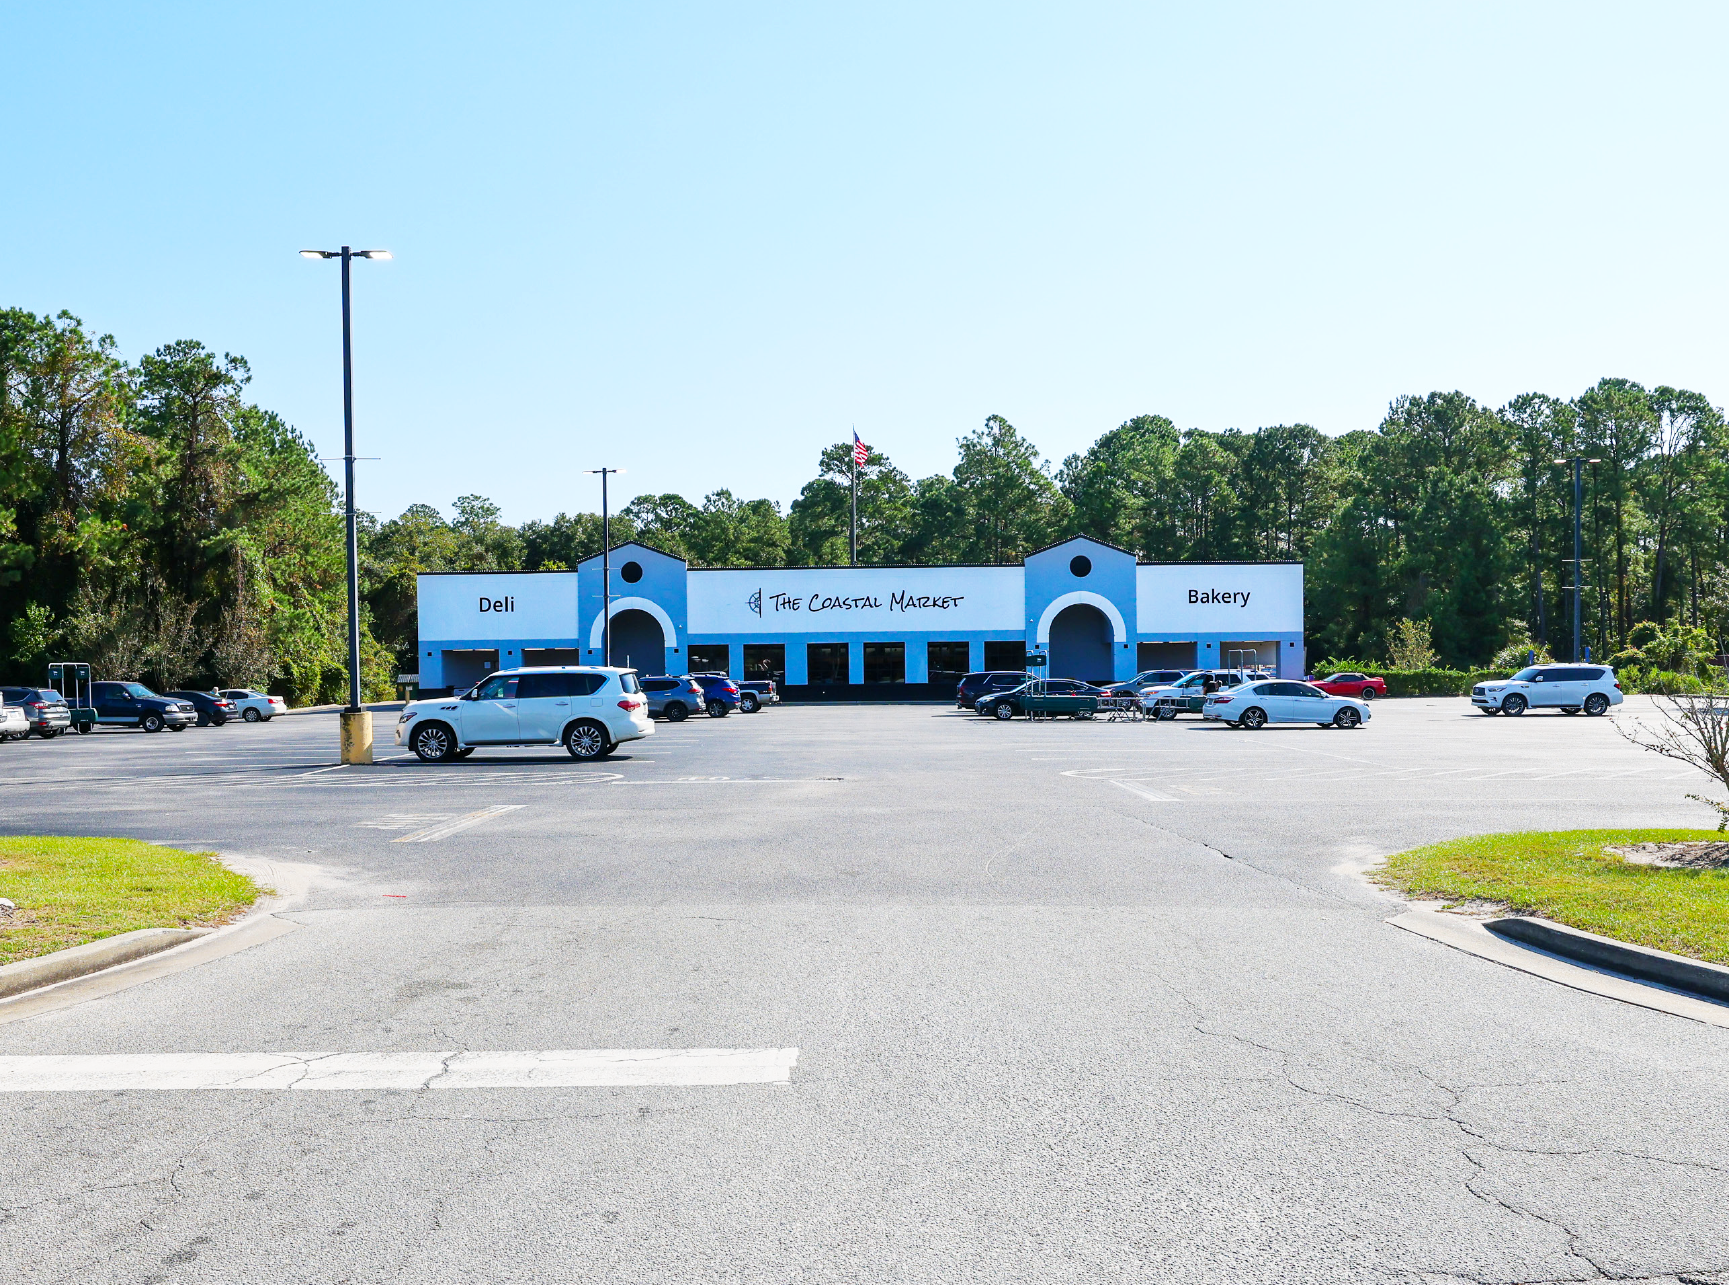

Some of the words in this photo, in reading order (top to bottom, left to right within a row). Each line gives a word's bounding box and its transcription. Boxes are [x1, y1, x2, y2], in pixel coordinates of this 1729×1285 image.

[479, 596, 515, 613] Deli
[769, 592, 803, 612] THE
[808, 593, 883, 613] COASTAL
[889, 589, 965, 613] MARKET
[1188, 588, 1251, 608] Bakery
